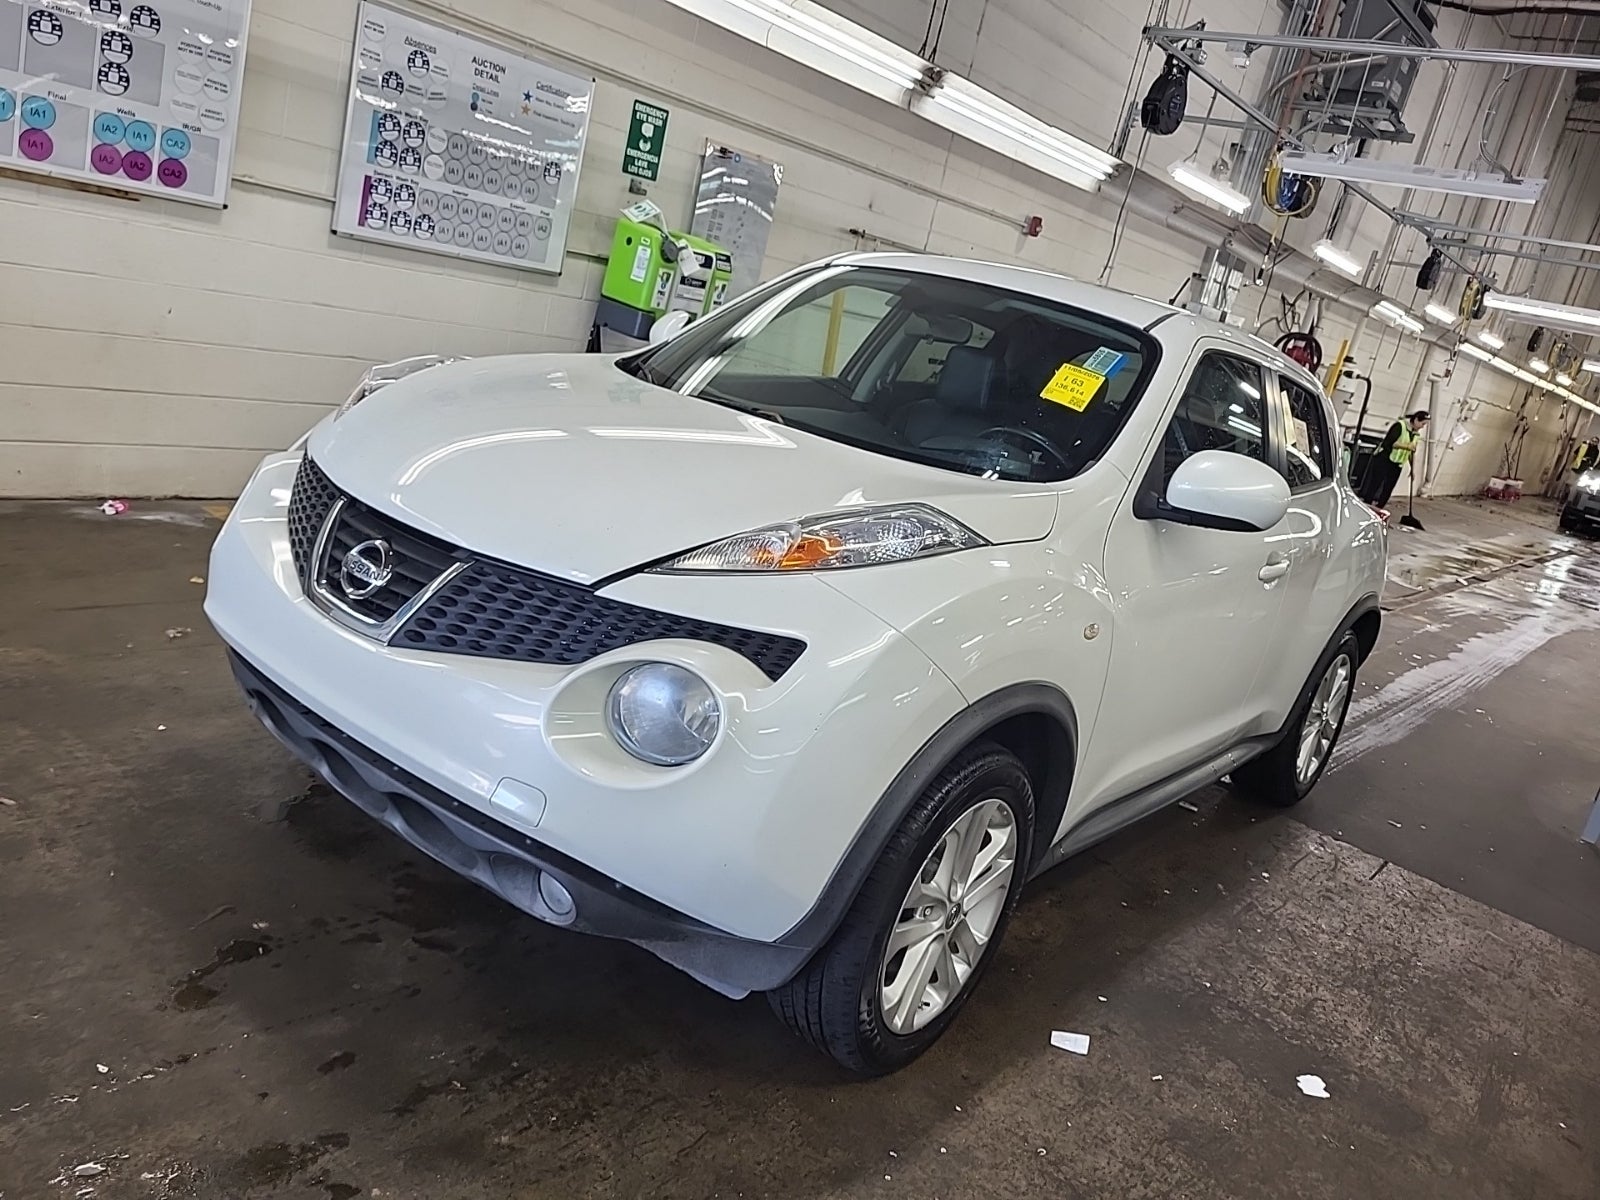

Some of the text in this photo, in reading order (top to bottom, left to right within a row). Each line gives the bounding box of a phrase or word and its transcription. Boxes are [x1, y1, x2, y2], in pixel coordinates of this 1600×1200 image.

[472, 56, 506, 75] AUCTION
[474, 67, 500, 84] DETAIL
[47, 90, 67, 100] Final
[30, 107, 46, 120] IA1
[635, 102, 667, 121] EMERGENCY
[636, 111, 648, 122] EYE
[102, 123, 118, 135] IA2
[132, 130, 148, 142] IA1
[27, 139, 44, 151] IA1
[166, 138, 186, 150] CA2
[99, 153, 114, 165] IA2
[634, 158, 649, 169] LAVE
[130, 160, 146, 172] IA2
[627, 163, 639, 174] LOS
[162, 167, 182, 179] CA2
[1070, 377, 1085, 387] 63
[343, 554, 383, 581] NISSAN
